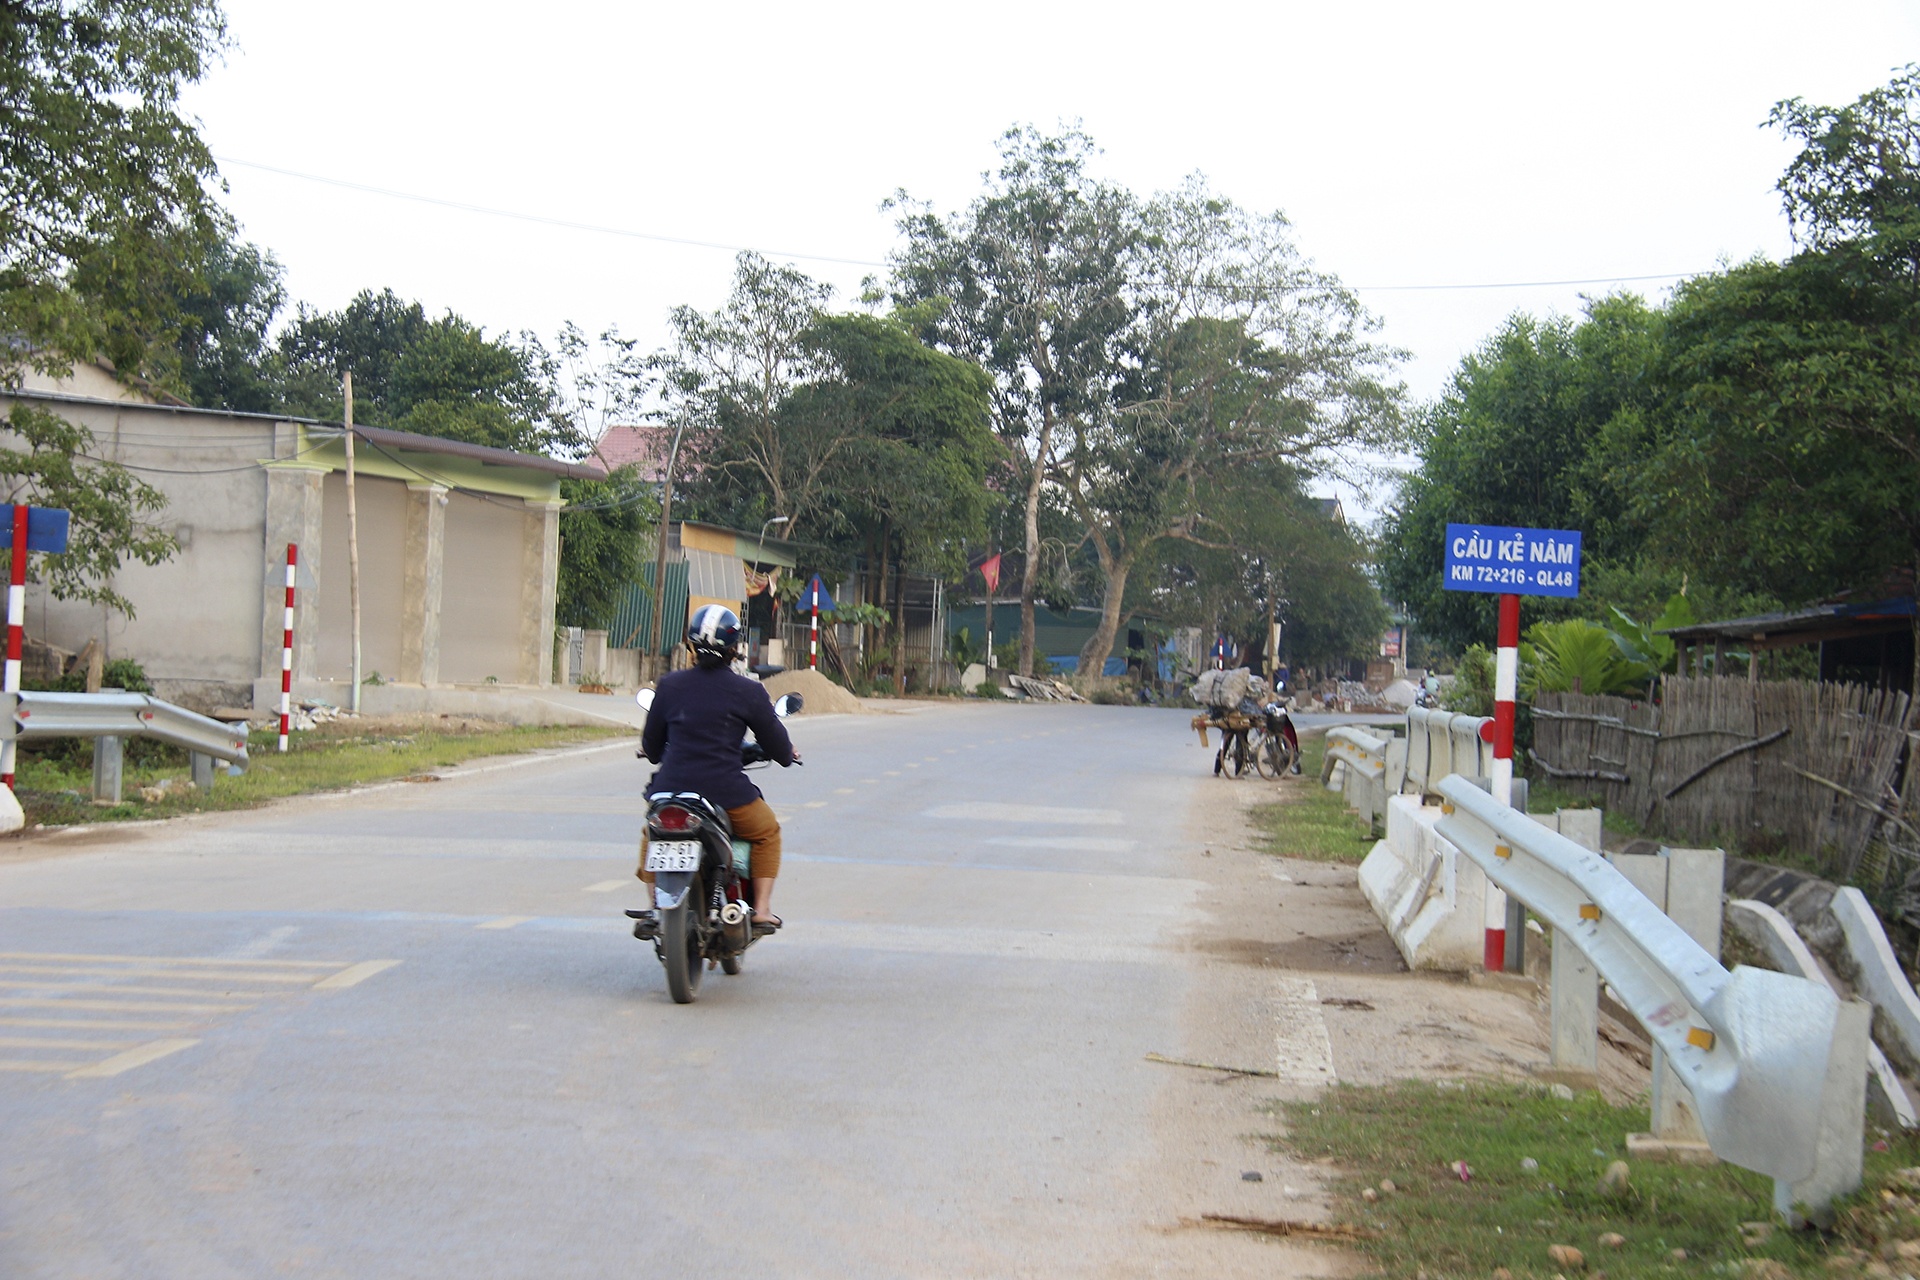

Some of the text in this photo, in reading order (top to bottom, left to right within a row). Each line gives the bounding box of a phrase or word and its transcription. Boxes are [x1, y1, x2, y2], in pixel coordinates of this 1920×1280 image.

[1453, 529, 1573, 564] CẦU KẺ NÂM
[1451, 564, 1473, 581] KM
[1477, 566, 1525, 584] 72+216
[1536, 570, 1573, 587] QL48
